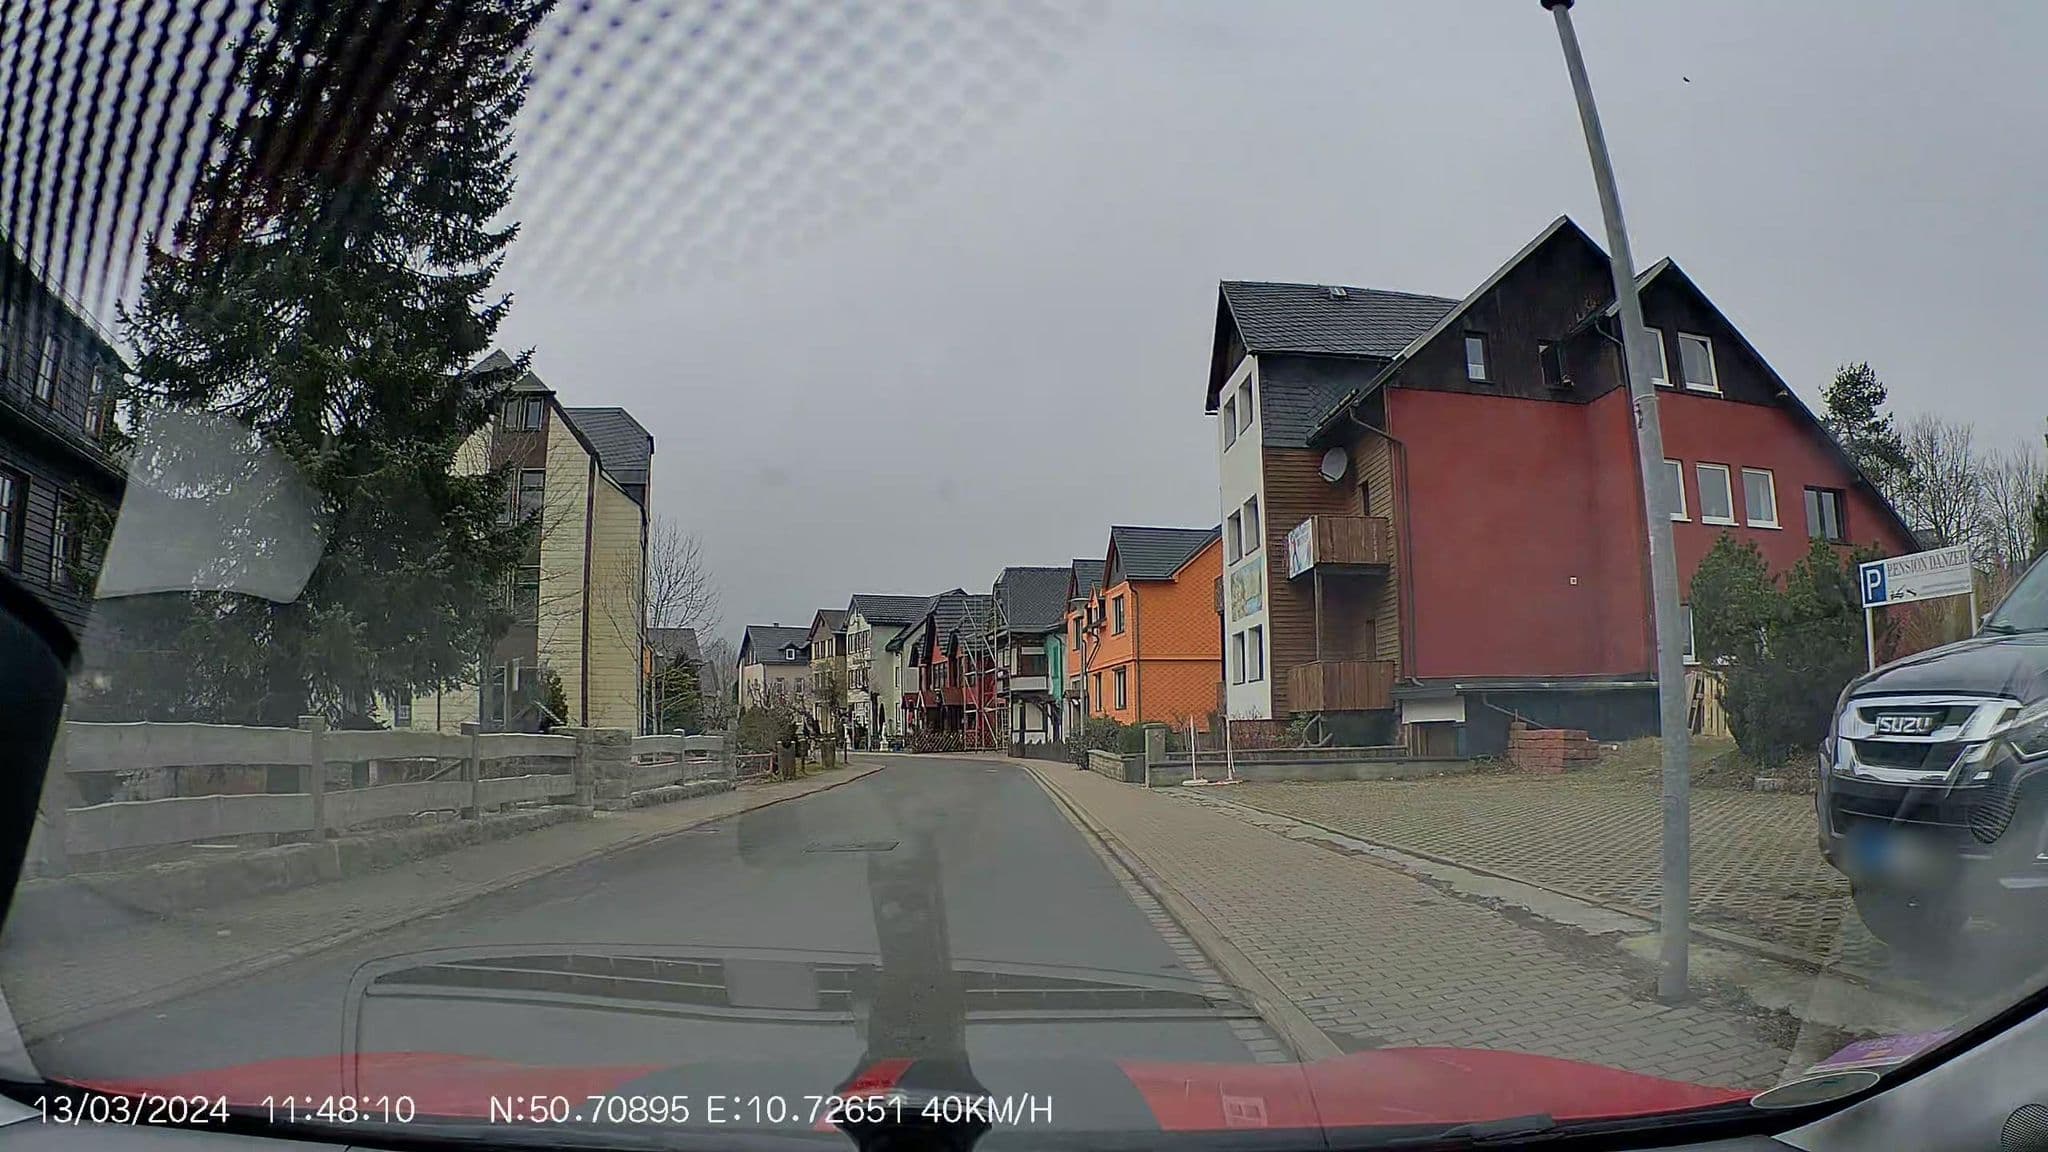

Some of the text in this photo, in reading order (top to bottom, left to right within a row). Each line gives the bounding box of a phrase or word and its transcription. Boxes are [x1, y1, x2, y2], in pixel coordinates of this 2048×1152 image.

[1887, 549, 1968, 578] PENSION DANZER
[1866, 569, 1881, 600] P
[1876, 716, 1934, 734] ISUZU
